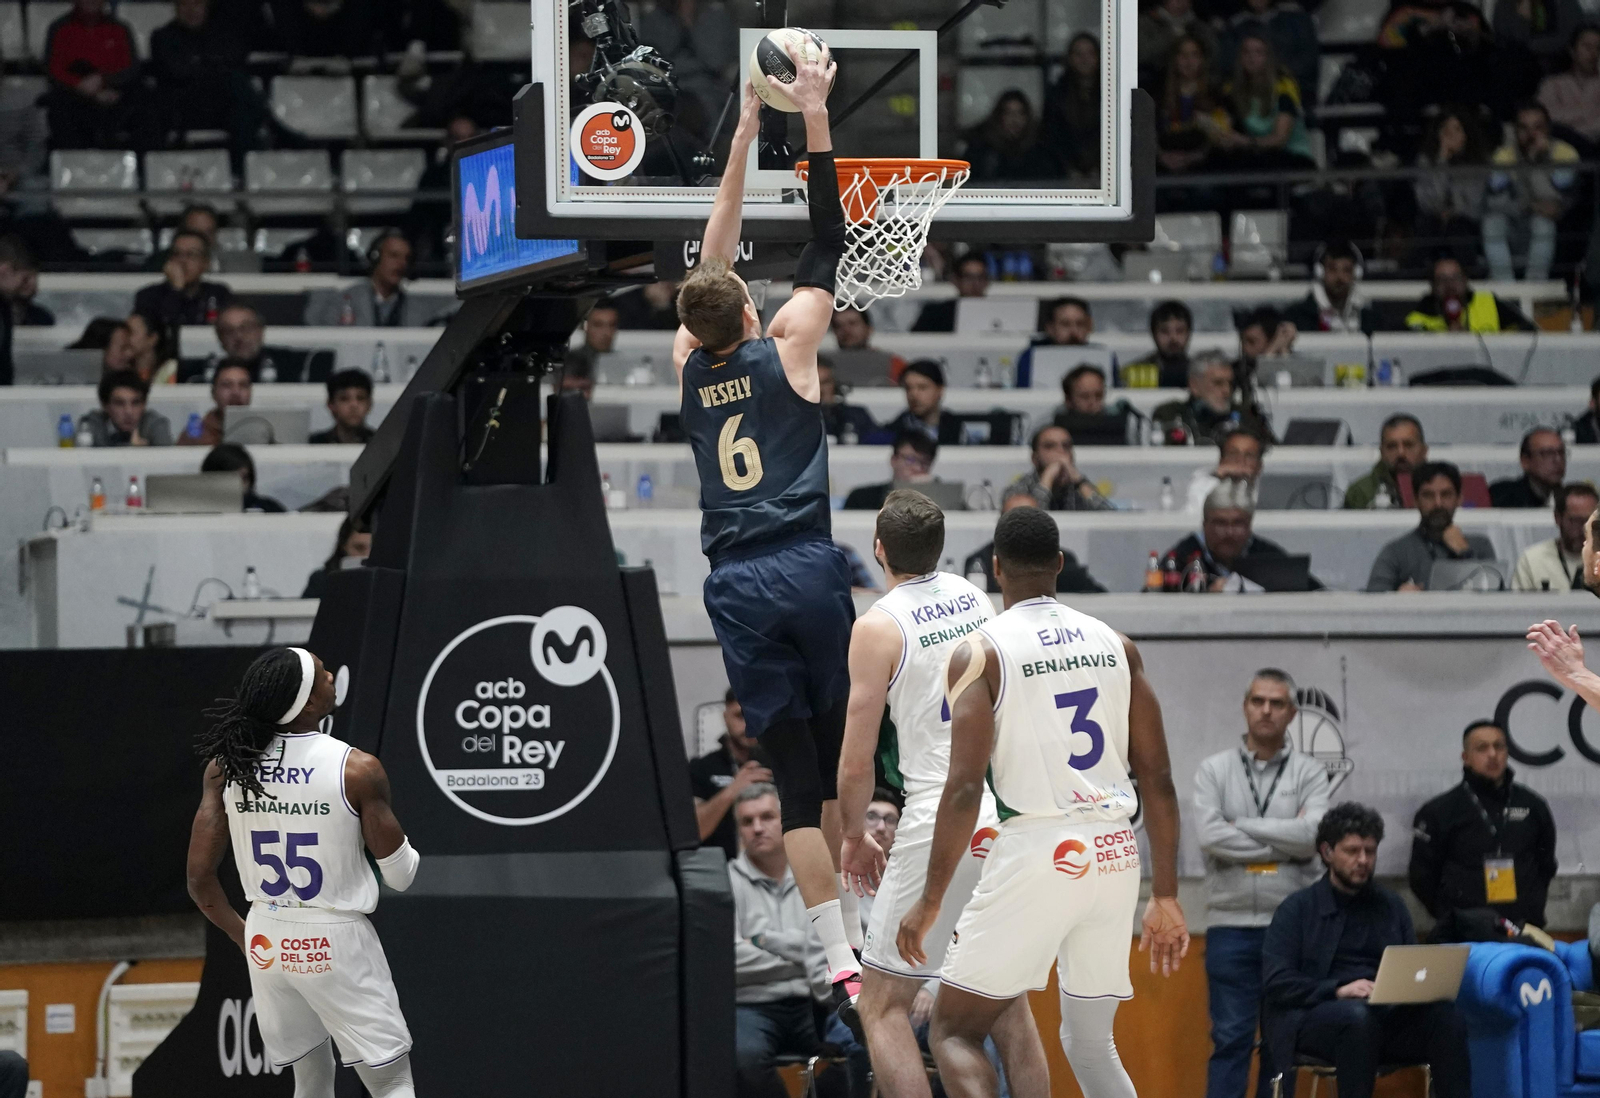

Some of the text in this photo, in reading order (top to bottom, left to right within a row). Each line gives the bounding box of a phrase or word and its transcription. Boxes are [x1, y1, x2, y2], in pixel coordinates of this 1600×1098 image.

[590, 135, 618, 145] Copa
[603, 145, 621, 156] Rey
[698, 375, 752, 408] VESELY
[718, 413, 764, 491] 6
[911, 592, 980, 625] KRAVISH
[1037, 626, 1085, 647] EJIM
[1022, 651, 1117, 678] BENAHAVÍS
[475, 677, 526, 699] acb
[455, 699, 551, 734] Copa
[1054, 687, 1105, 771] 3
[461, 734, 566, 769] del Rey
[447, 773, 541, 787] Badalona '23
[235, 800, 331, 816] BENAHAVÍS
[1094, 829, 1136, 849] COSTA
[250, 830, 323, 901] 55
[1096, 848, 1121, 863] DEL
[281, 937, 331, 951] COSTA
[281, 951, 332, 963] DEL SOL
[282, 962, 333, 974] MÁLAGA
